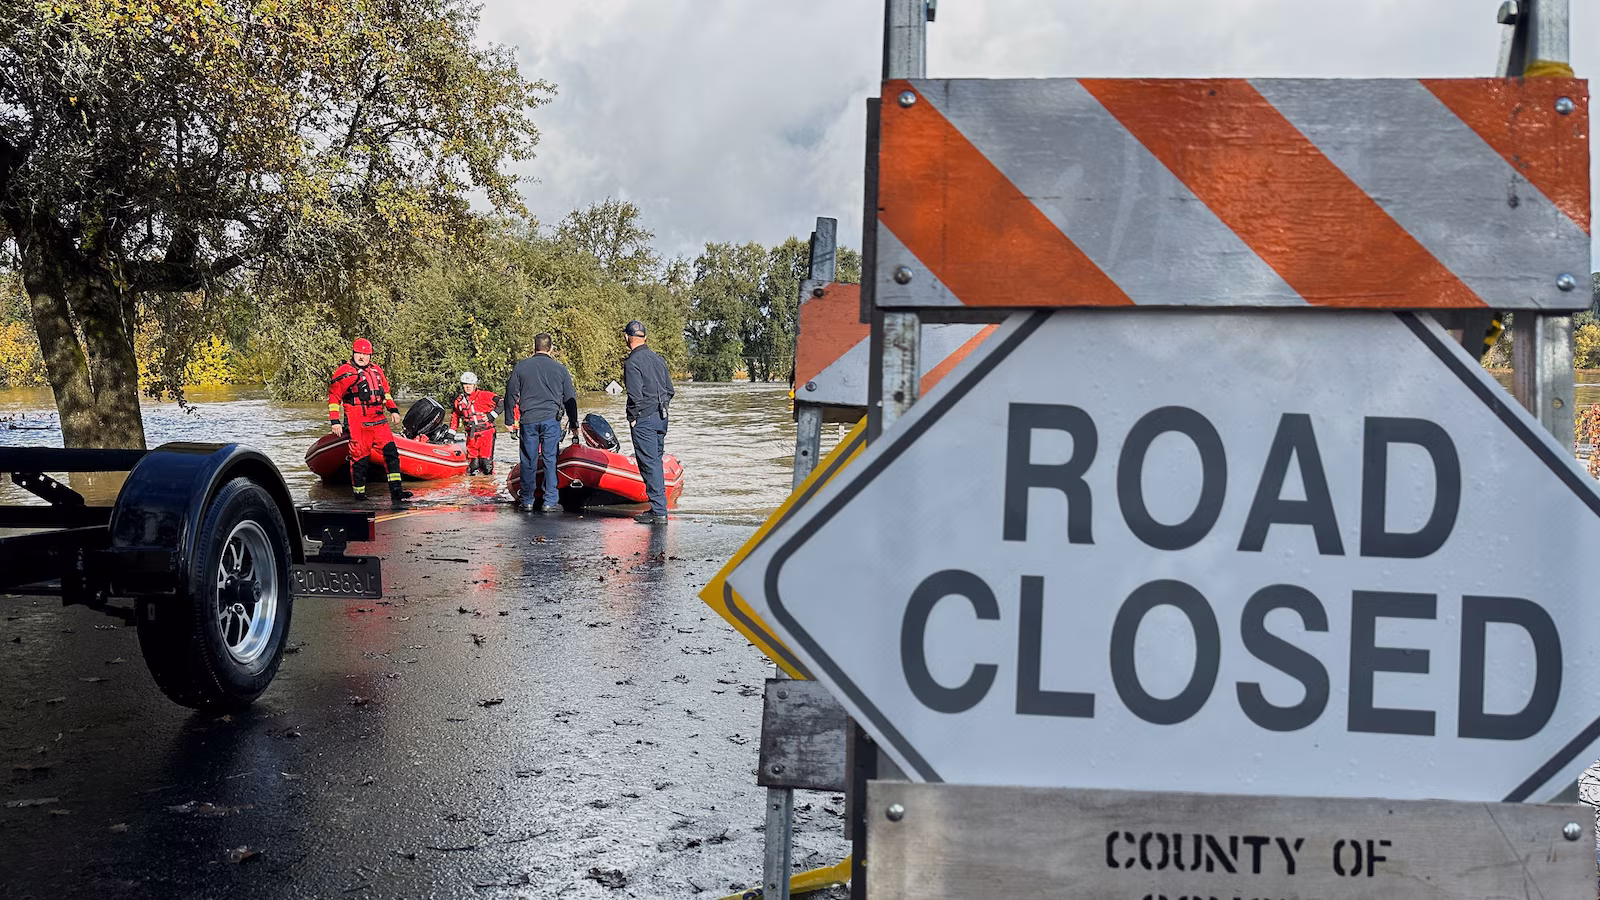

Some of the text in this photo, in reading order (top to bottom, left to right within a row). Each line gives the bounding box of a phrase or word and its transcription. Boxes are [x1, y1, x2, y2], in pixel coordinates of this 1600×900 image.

[1003, 403, 1461, 558] ROAD
[900, 569, 1563, 740] CLOSED
[1106, 831, 1391, 877] COUNTY OF
